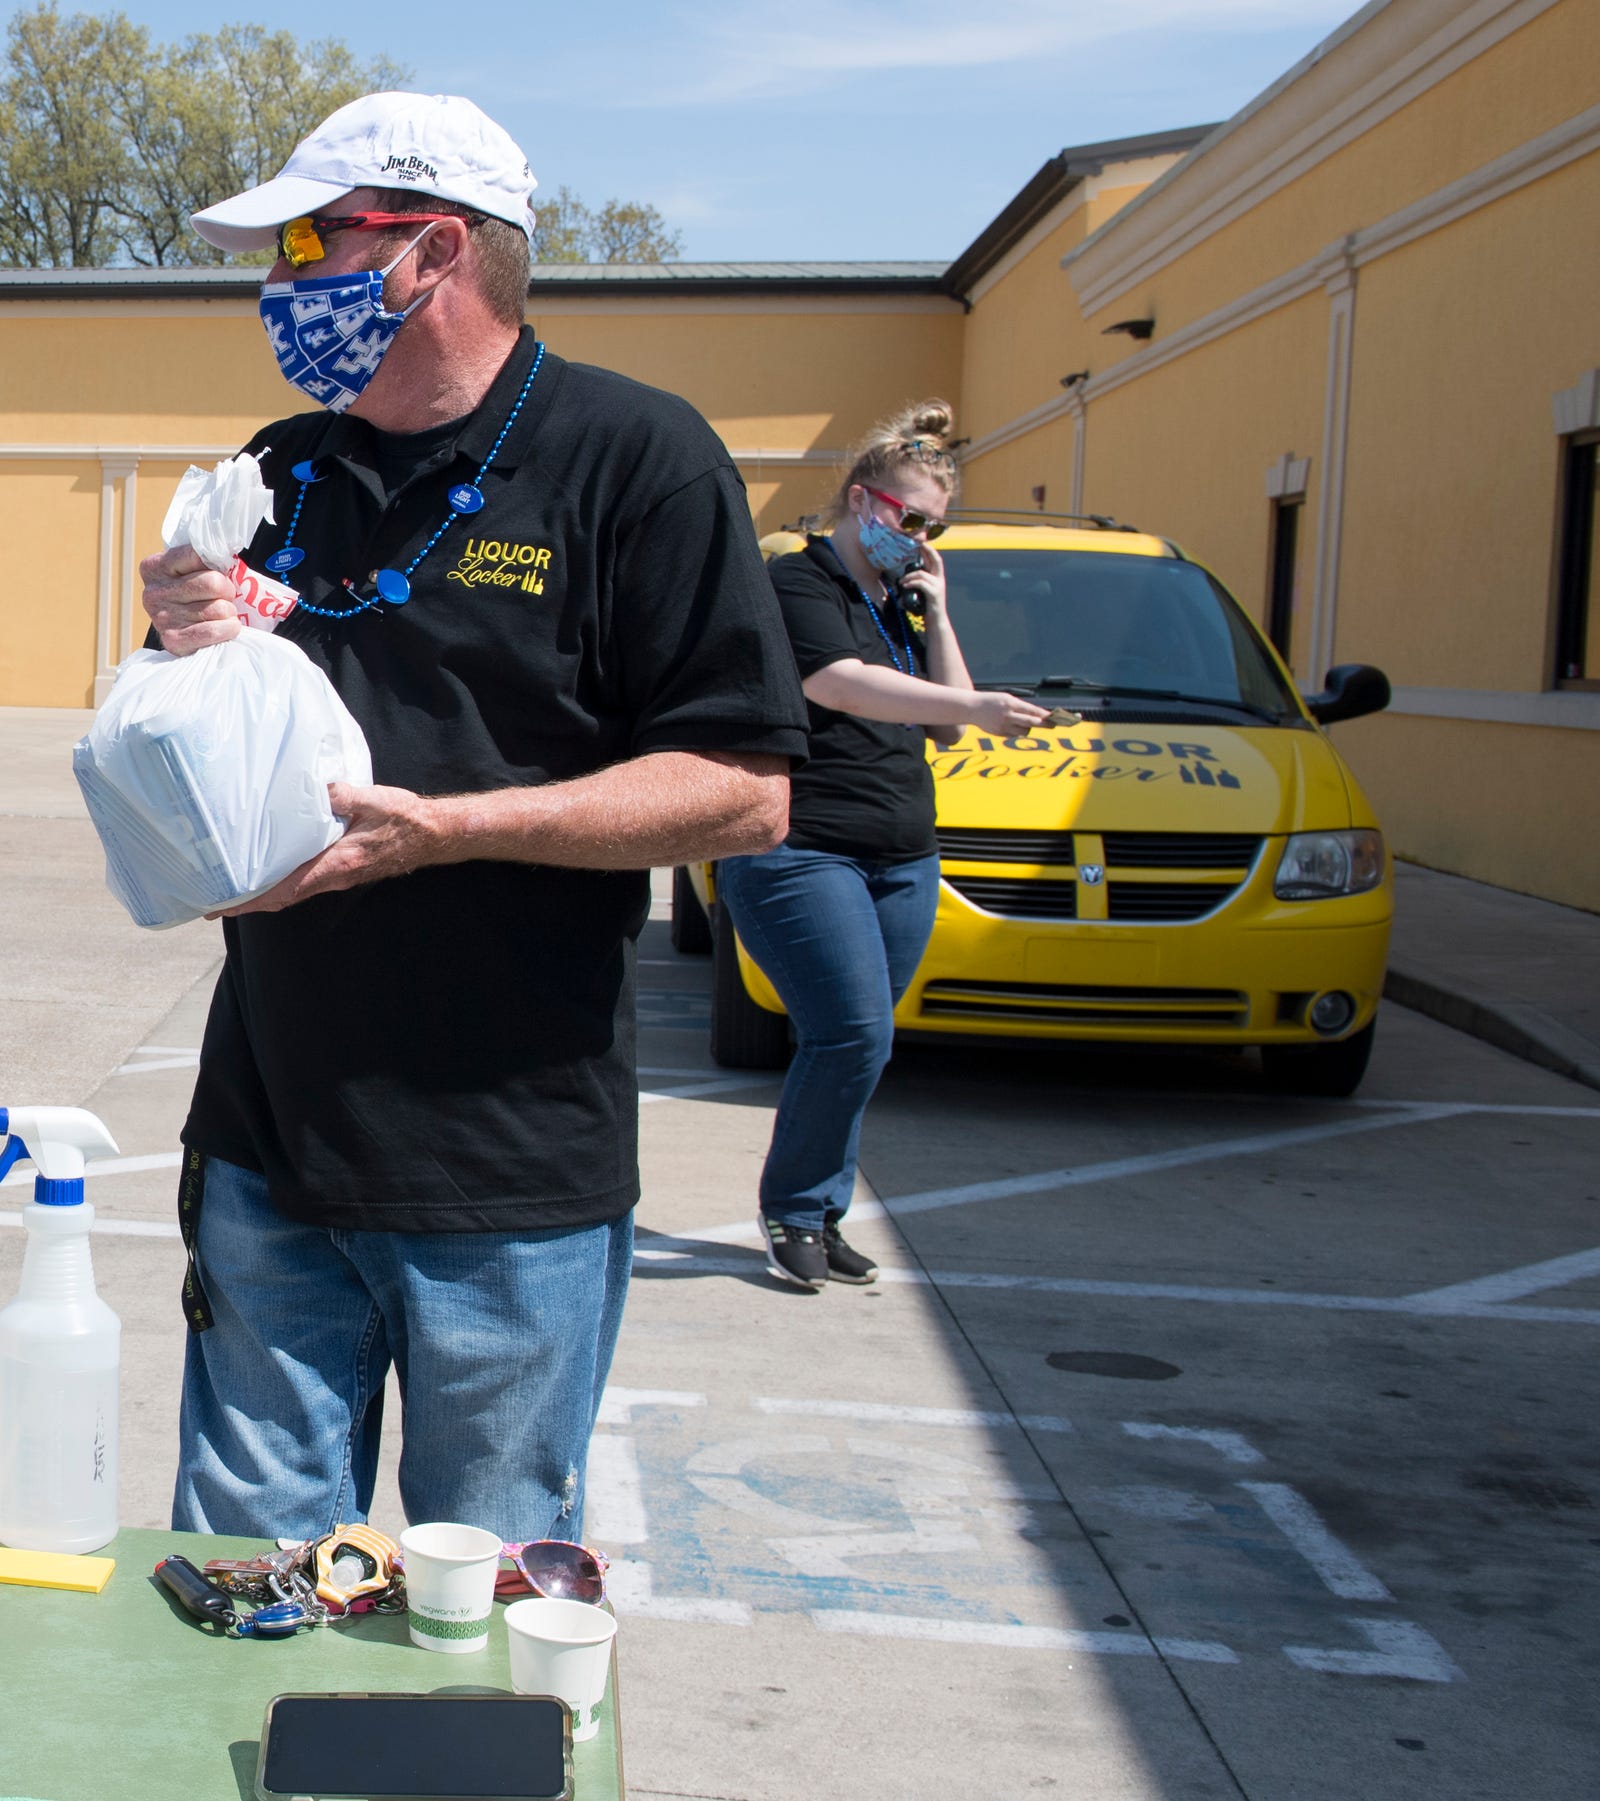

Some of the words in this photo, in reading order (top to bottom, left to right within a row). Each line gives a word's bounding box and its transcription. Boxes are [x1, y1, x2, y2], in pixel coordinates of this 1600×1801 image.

[381, 155, 407, 172] JIM
[408, 156, 438, 181] BEAM
[464, 539, 552, 570] LIQUOR
[447, 557, 522, 588] Locker
[934, 737, 1221, 762] LIQUOR
[931, 754, 1174, 782] Locker
[419, 1604, 456, 1616] vegware
